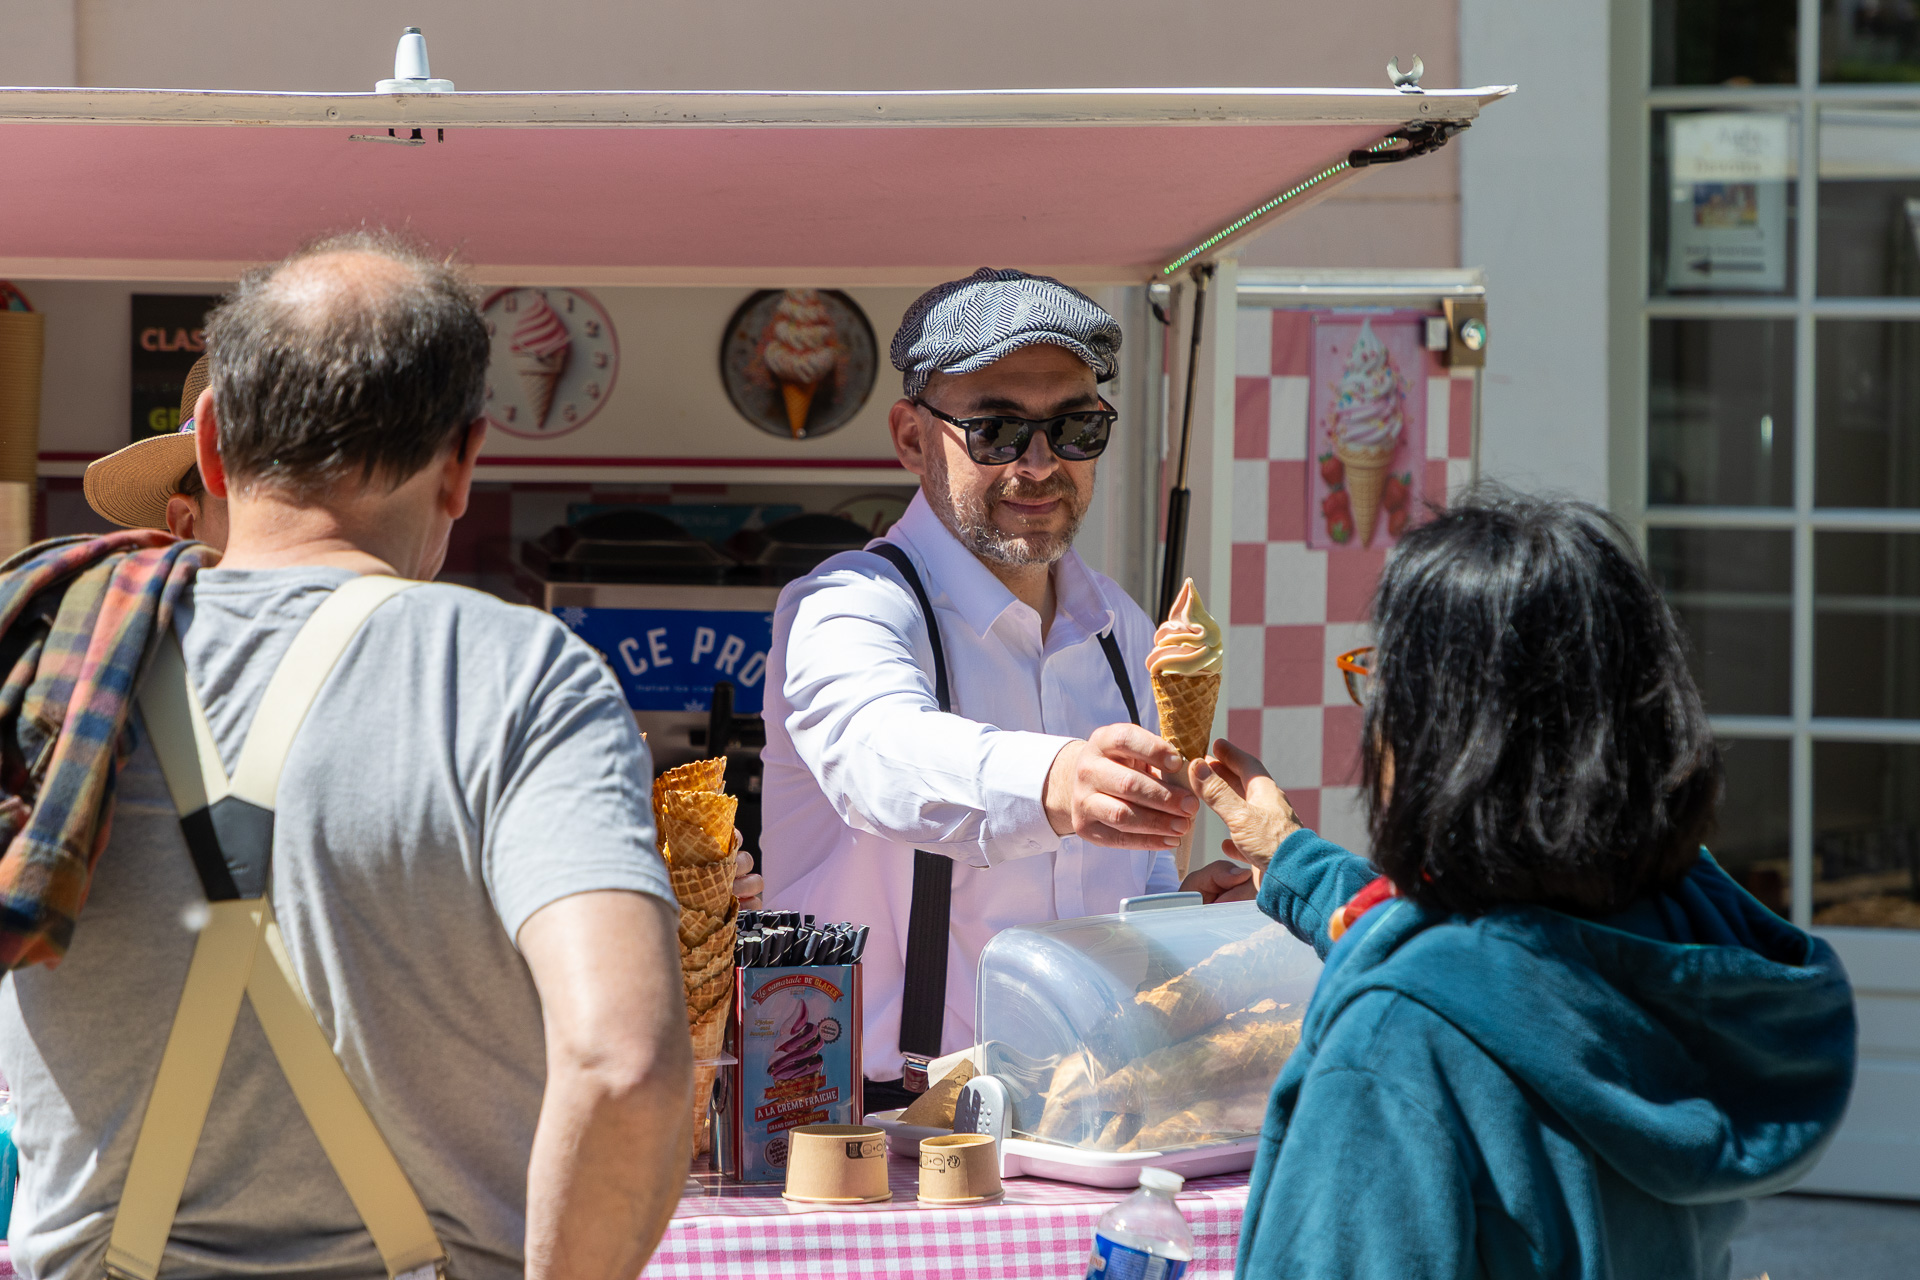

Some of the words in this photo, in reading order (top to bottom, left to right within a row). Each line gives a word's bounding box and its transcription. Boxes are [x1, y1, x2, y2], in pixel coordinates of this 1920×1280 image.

[601, 627, 674, 676] CE
[814, 978, 839, 998] GLACES
[757, 1109, 764, 1119] A
[765, 1105, 776, 1116] LA
[777, 1099, 804, 1113] CRÈME
[769, 1122, 784, 1131] GRAND
